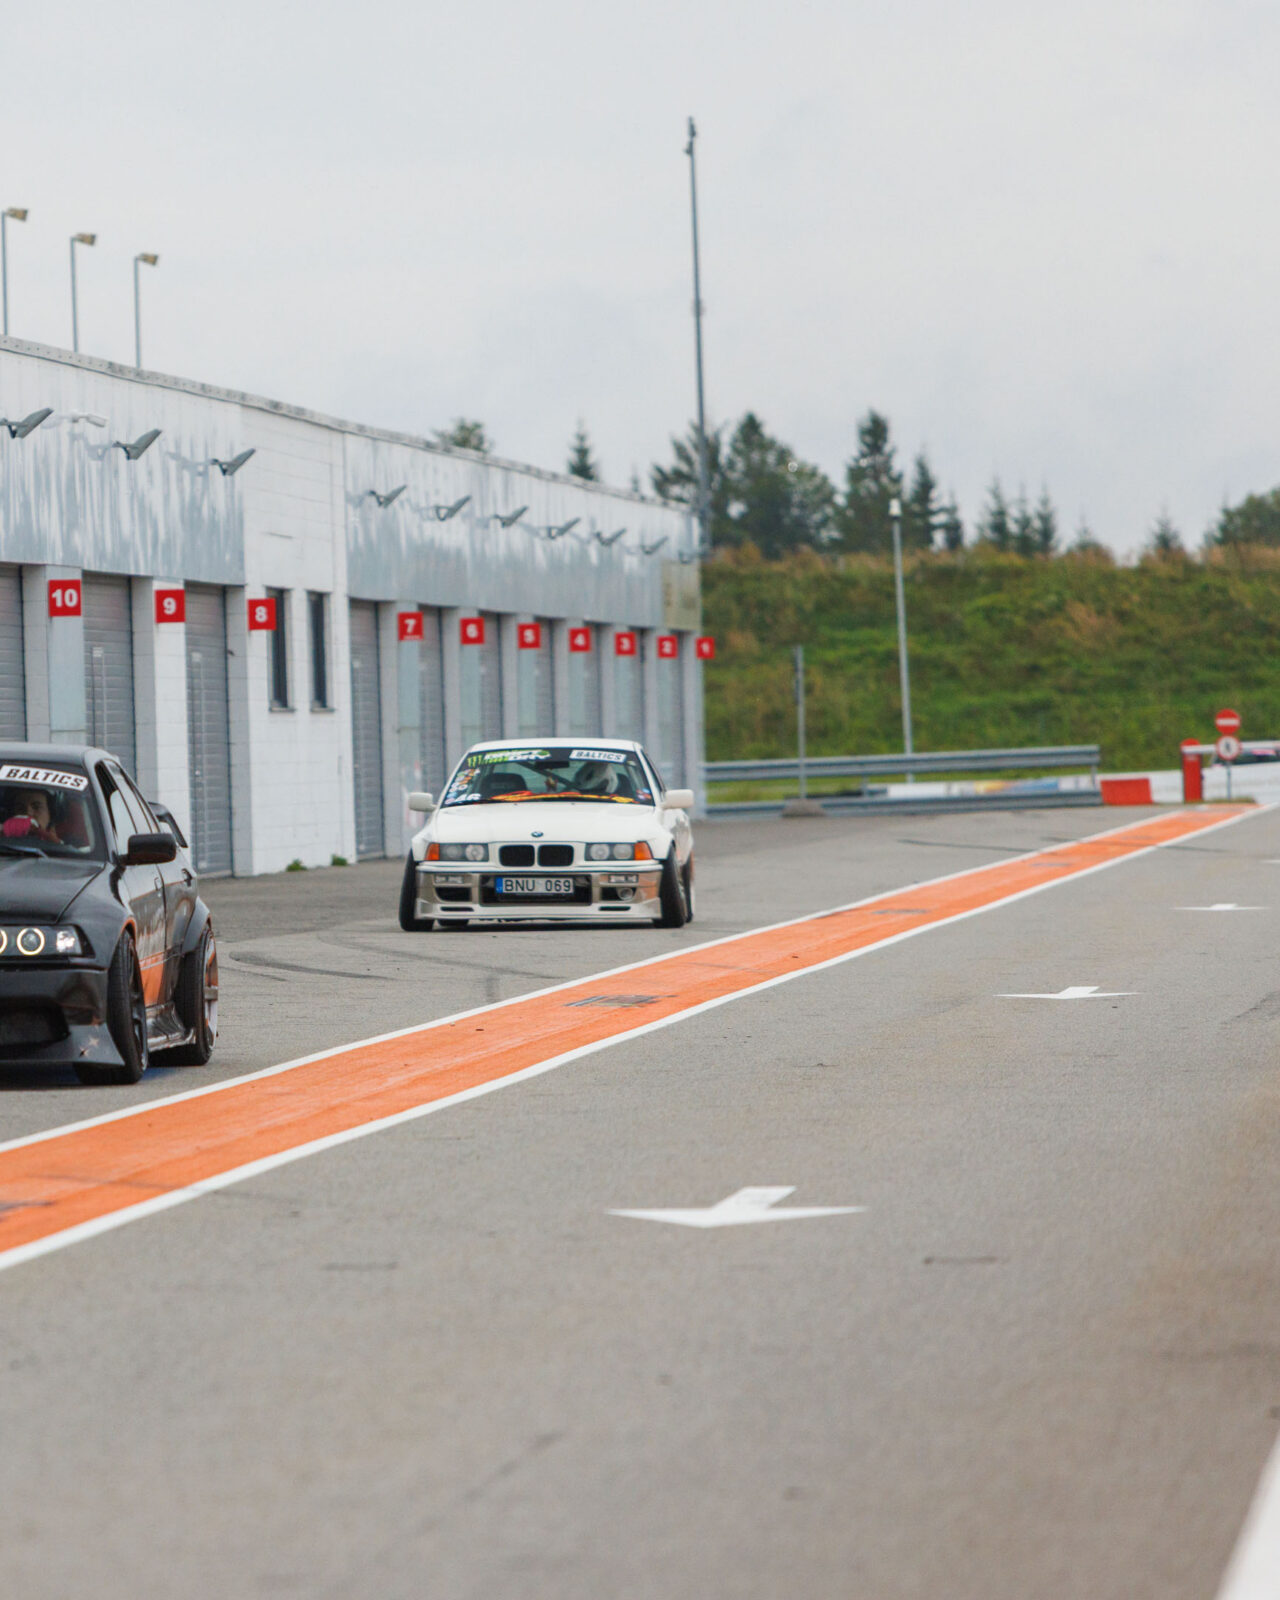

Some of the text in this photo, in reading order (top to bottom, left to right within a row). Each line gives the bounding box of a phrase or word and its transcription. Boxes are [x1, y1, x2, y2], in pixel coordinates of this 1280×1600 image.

[51, 588, 78, 608] 10
[162, 597, 177, 615] 9
[254, 605, 268, 623] 8
[404, 618, 417, 634] 7
[466, 623, 478, 638] 6
[523, 629, 535, 643] 5
[574, 633, 585, 646] 4
[621, 637, 631, 651] 3
[663, 641, 672, 654] 2
[701, 642, 710, 654] 1
[575, 751, 622, 761] BALTICS
[6, 768, 84, 787] BALTICS
[504, 879, 571, 892] BNU 069
